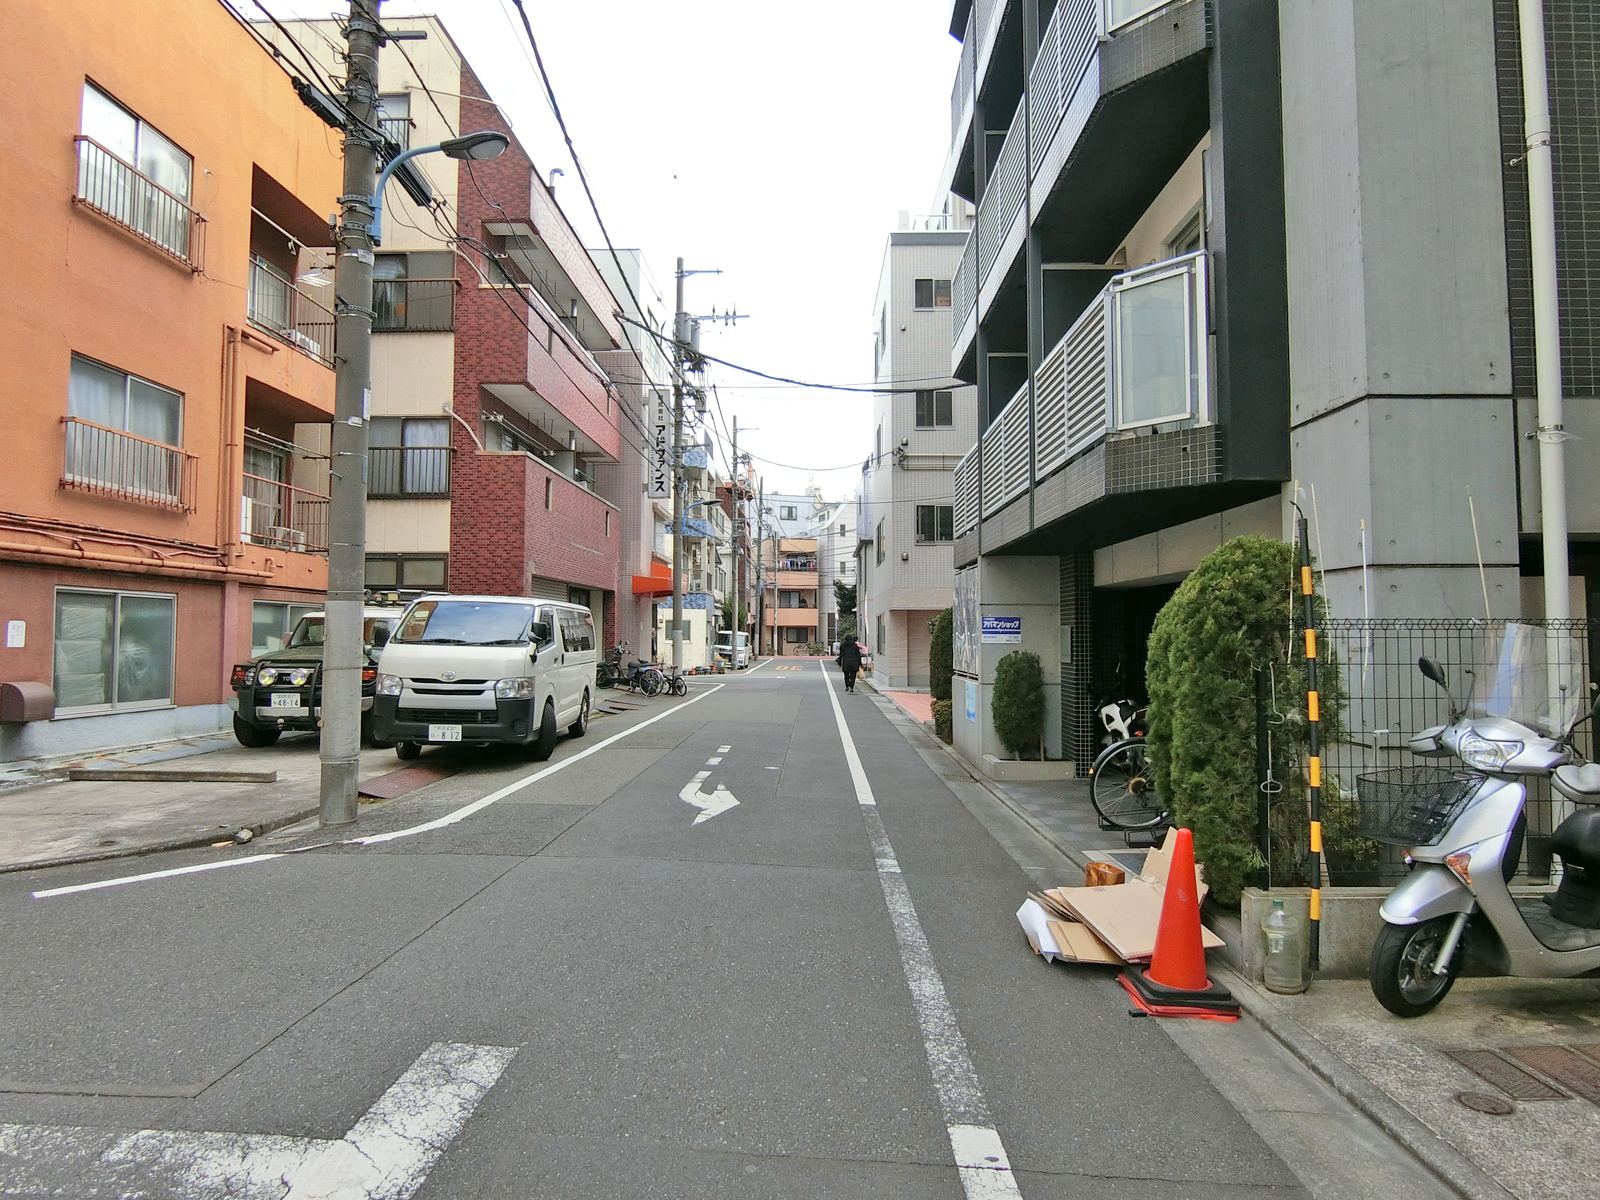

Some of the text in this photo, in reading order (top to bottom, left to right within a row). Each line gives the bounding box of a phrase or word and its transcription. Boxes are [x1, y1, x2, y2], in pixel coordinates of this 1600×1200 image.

[982, 620, 1020, 628] アパマンショップ
